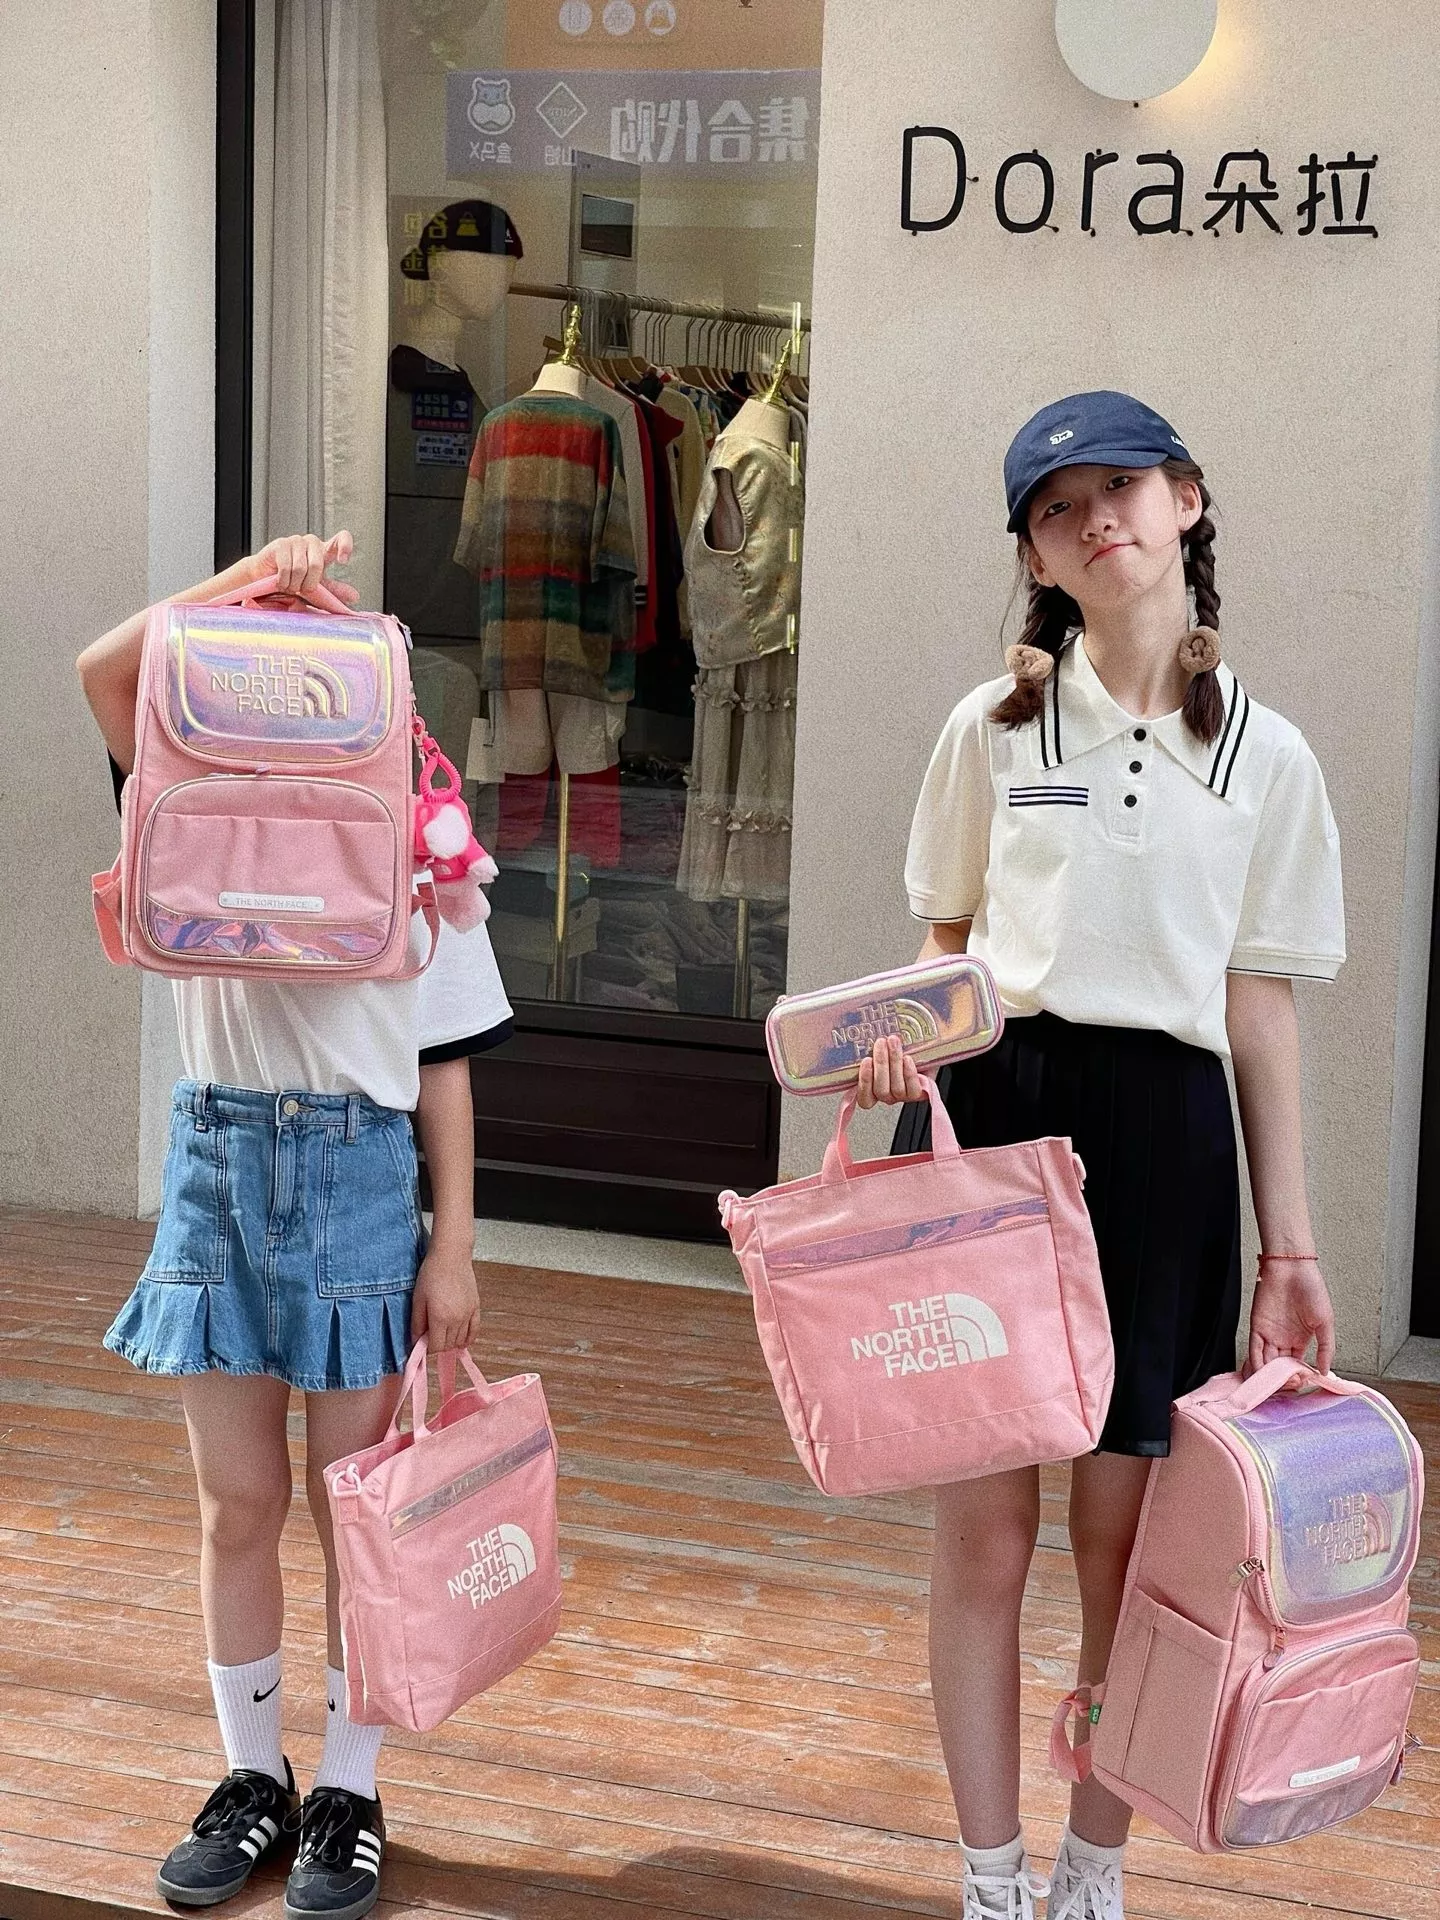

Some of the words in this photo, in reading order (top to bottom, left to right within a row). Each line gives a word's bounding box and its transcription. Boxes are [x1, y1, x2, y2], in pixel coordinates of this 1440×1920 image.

[252, 654, 302, 676] THE
[210, 671, 302, 696] NORTH
[237, 694, 302, 717] FACE
[857, 1001, 896, 1021] THE
[831, 1016, 900, 1048] NORTH
[888, 1295, 948, 1328] THE
[851, 1319, 953, 1360] NORTH
[884, 1343, 957, 1378] FACE
[1328, 1494, 1364, 1519] THE
[466, 1527, 503, 1562] THE
[1304, 1515, 1364, 1548] NORTH
[1324, 1539, 1364, 1568] FACE
[446, 1548, 507, 1600] NORTH
[469, 1567, 511, 1610] FACE
